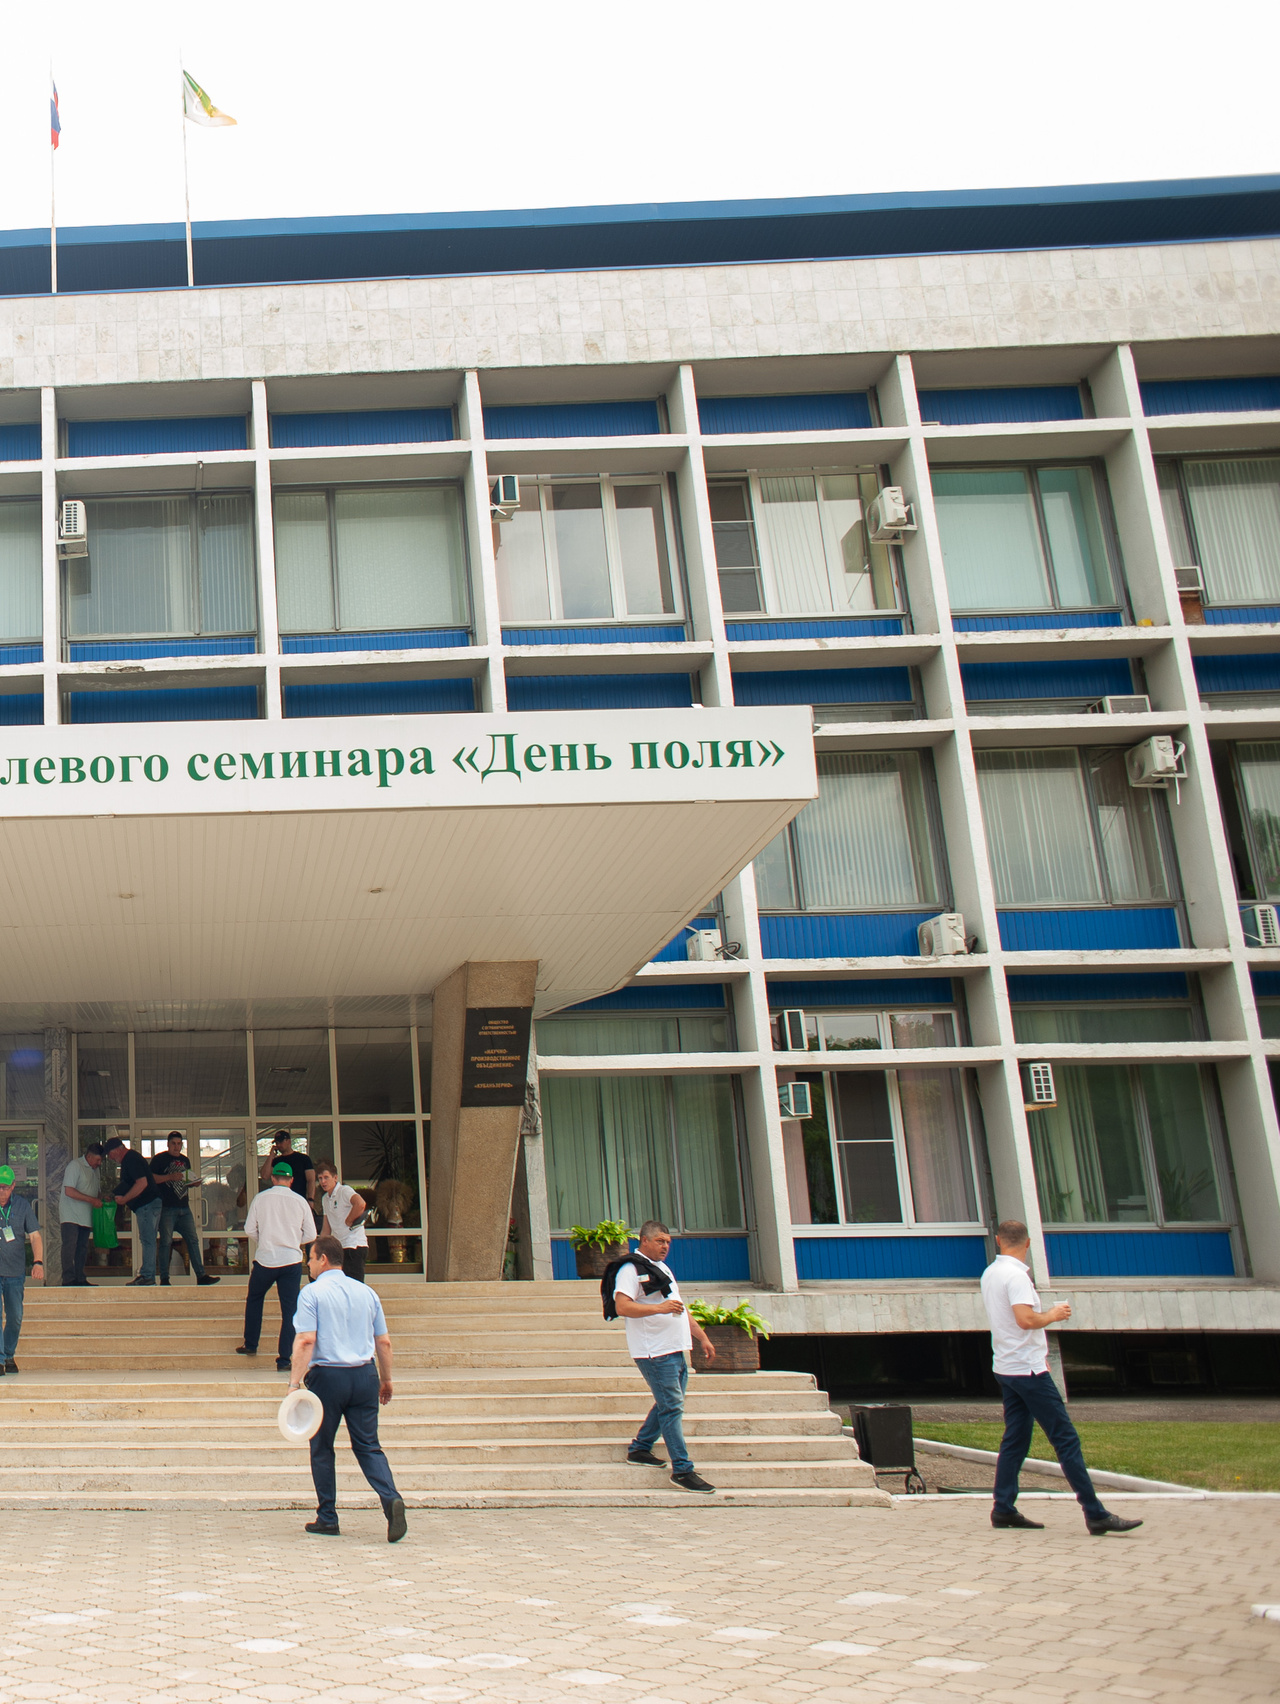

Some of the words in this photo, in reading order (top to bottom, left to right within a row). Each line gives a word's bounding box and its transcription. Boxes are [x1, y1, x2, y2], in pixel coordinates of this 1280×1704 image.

[186, 748, 434, 789] семинара
[452, 733, 612, 784] «День
[630, 740, 788, 771] поля»
